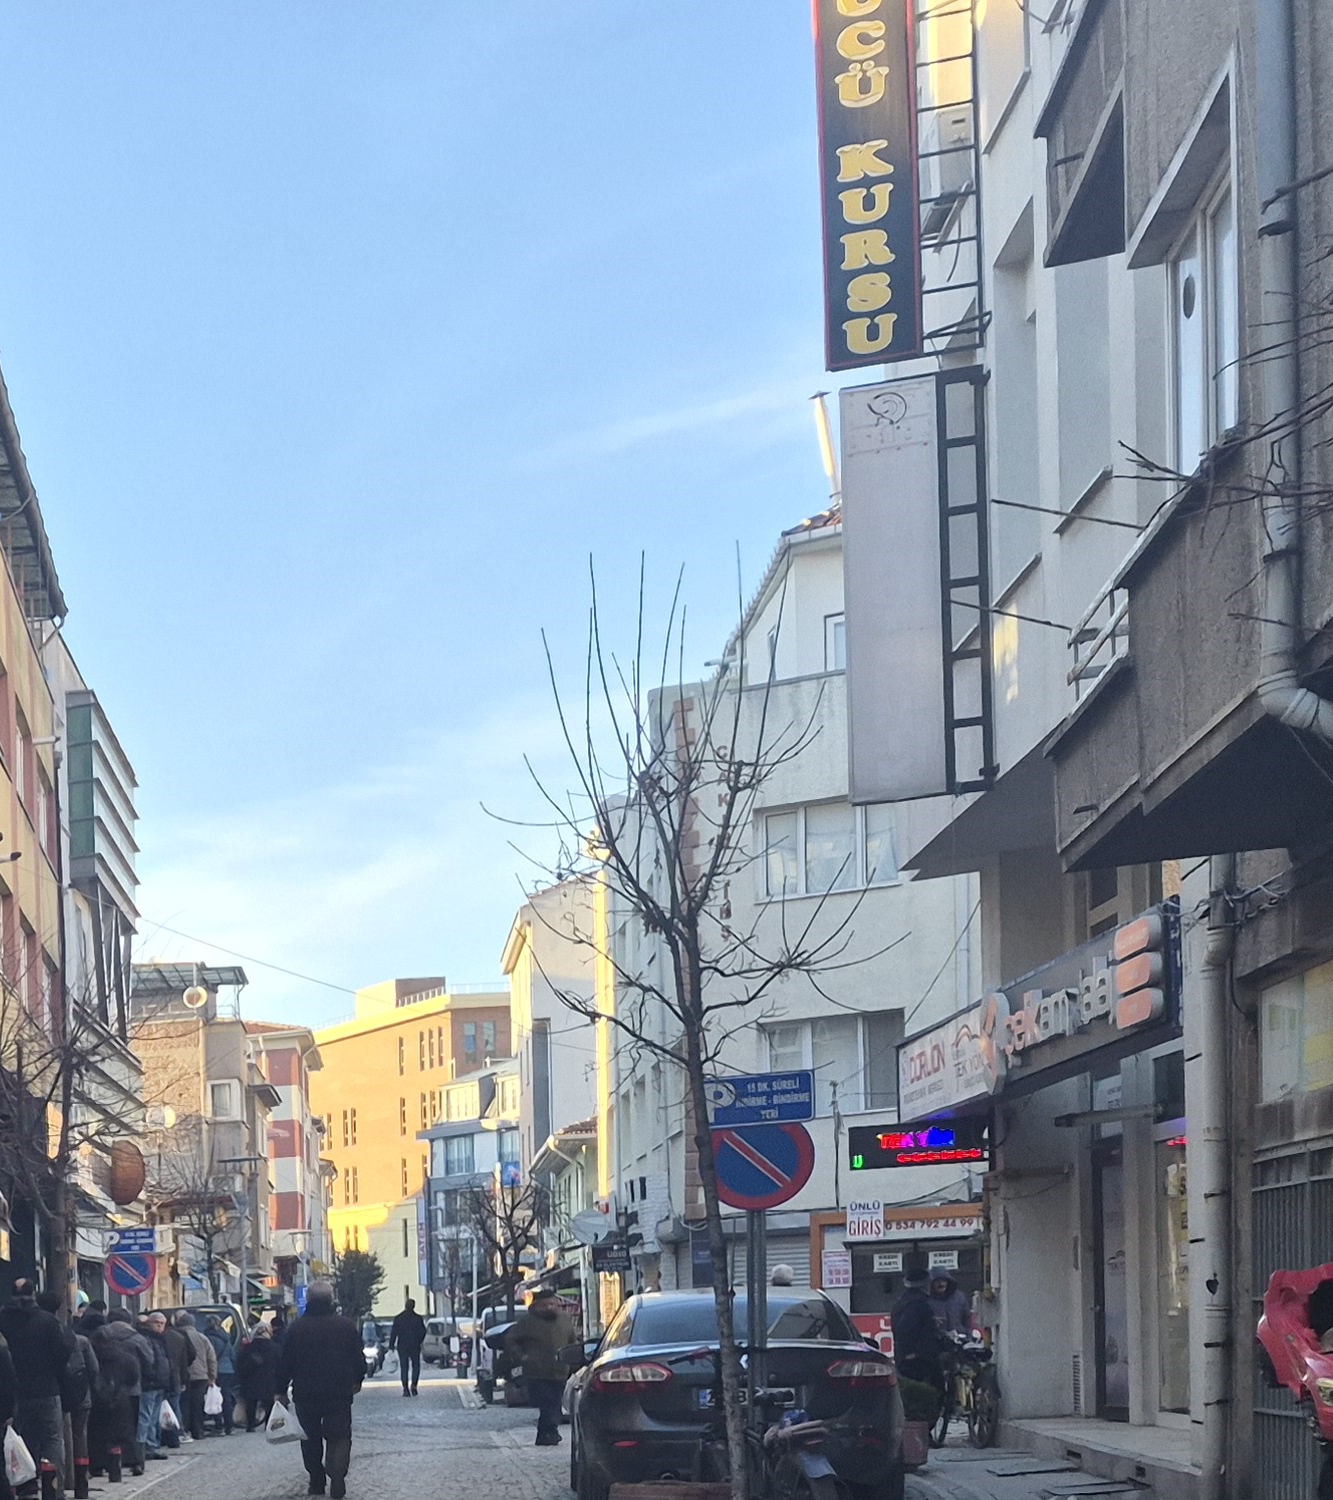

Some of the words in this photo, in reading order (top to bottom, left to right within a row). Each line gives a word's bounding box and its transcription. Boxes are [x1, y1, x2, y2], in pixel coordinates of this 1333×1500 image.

[835, 139, 897, 355] KURSU
[850, 1201, 880, 1211] ÜNLÜ
[849, 1216, 881, 1237] GİRİŞ
